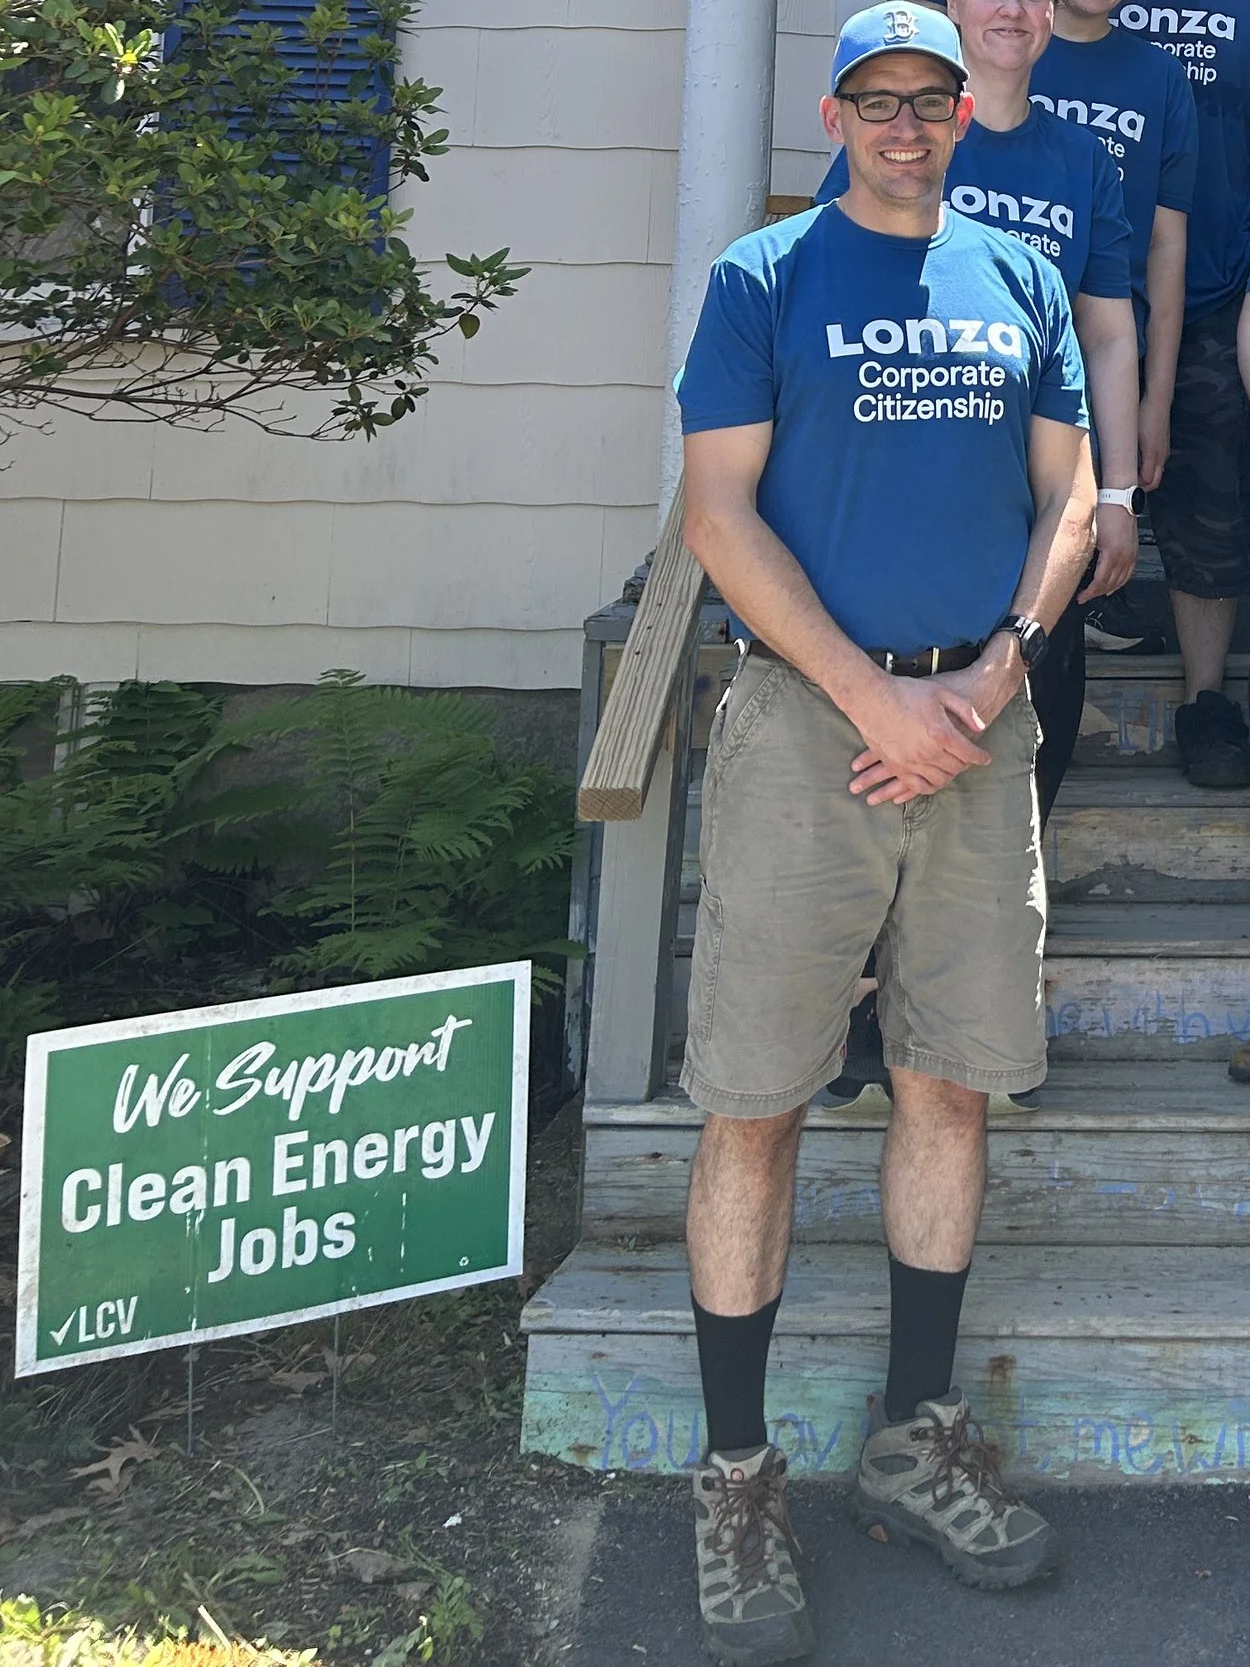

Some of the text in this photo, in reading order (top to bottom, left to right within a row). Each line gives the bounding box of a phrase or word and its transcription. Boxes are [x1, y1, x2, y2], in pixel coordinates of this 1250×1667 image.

[1108, 4, 1236, 41] onza
[950, 185, 1074, 239] onza
[826, 318, 1022, 359] Lonza
[858, 360, 1006, 393] Corporate
[853, 391, 1005, 425] Citizenship
[112, 1013, 473, 1134] We Support
[60, 1111, 496, 1235] Clean Energy
[207, 1205, 358, 1284] Jobs
[77, 1295, 139, 1344] LCV
